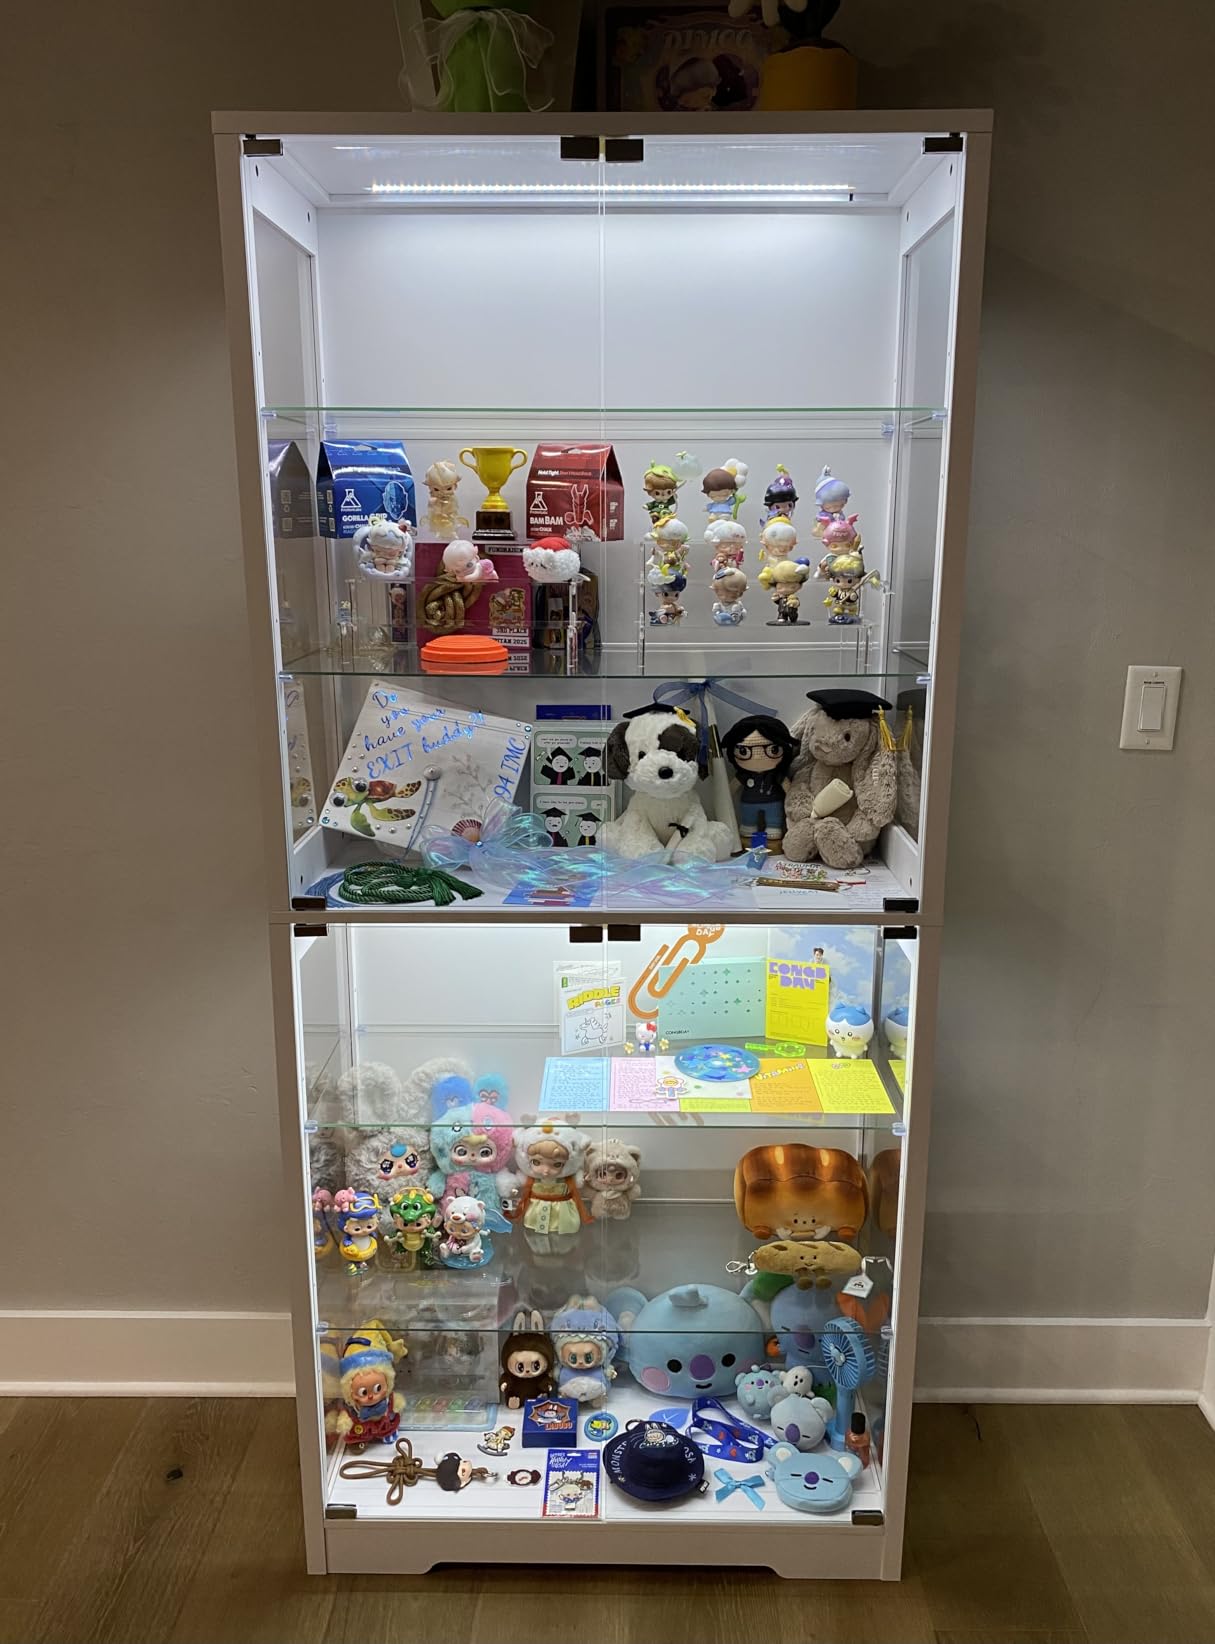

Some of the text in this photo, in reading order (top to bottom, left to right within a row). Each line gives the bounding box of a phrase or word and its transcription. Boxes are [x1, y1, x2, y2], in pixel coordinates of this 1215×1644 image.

[529, 516, 564, 526] BAM BAM
[372, 690, 398, 709] Do
[380, 707, 409, 729] you
[364, 726, 406, 752] have
[366, 742, 415, 779] EXIT
[567, 985, 621, 1010] RIDDLE
